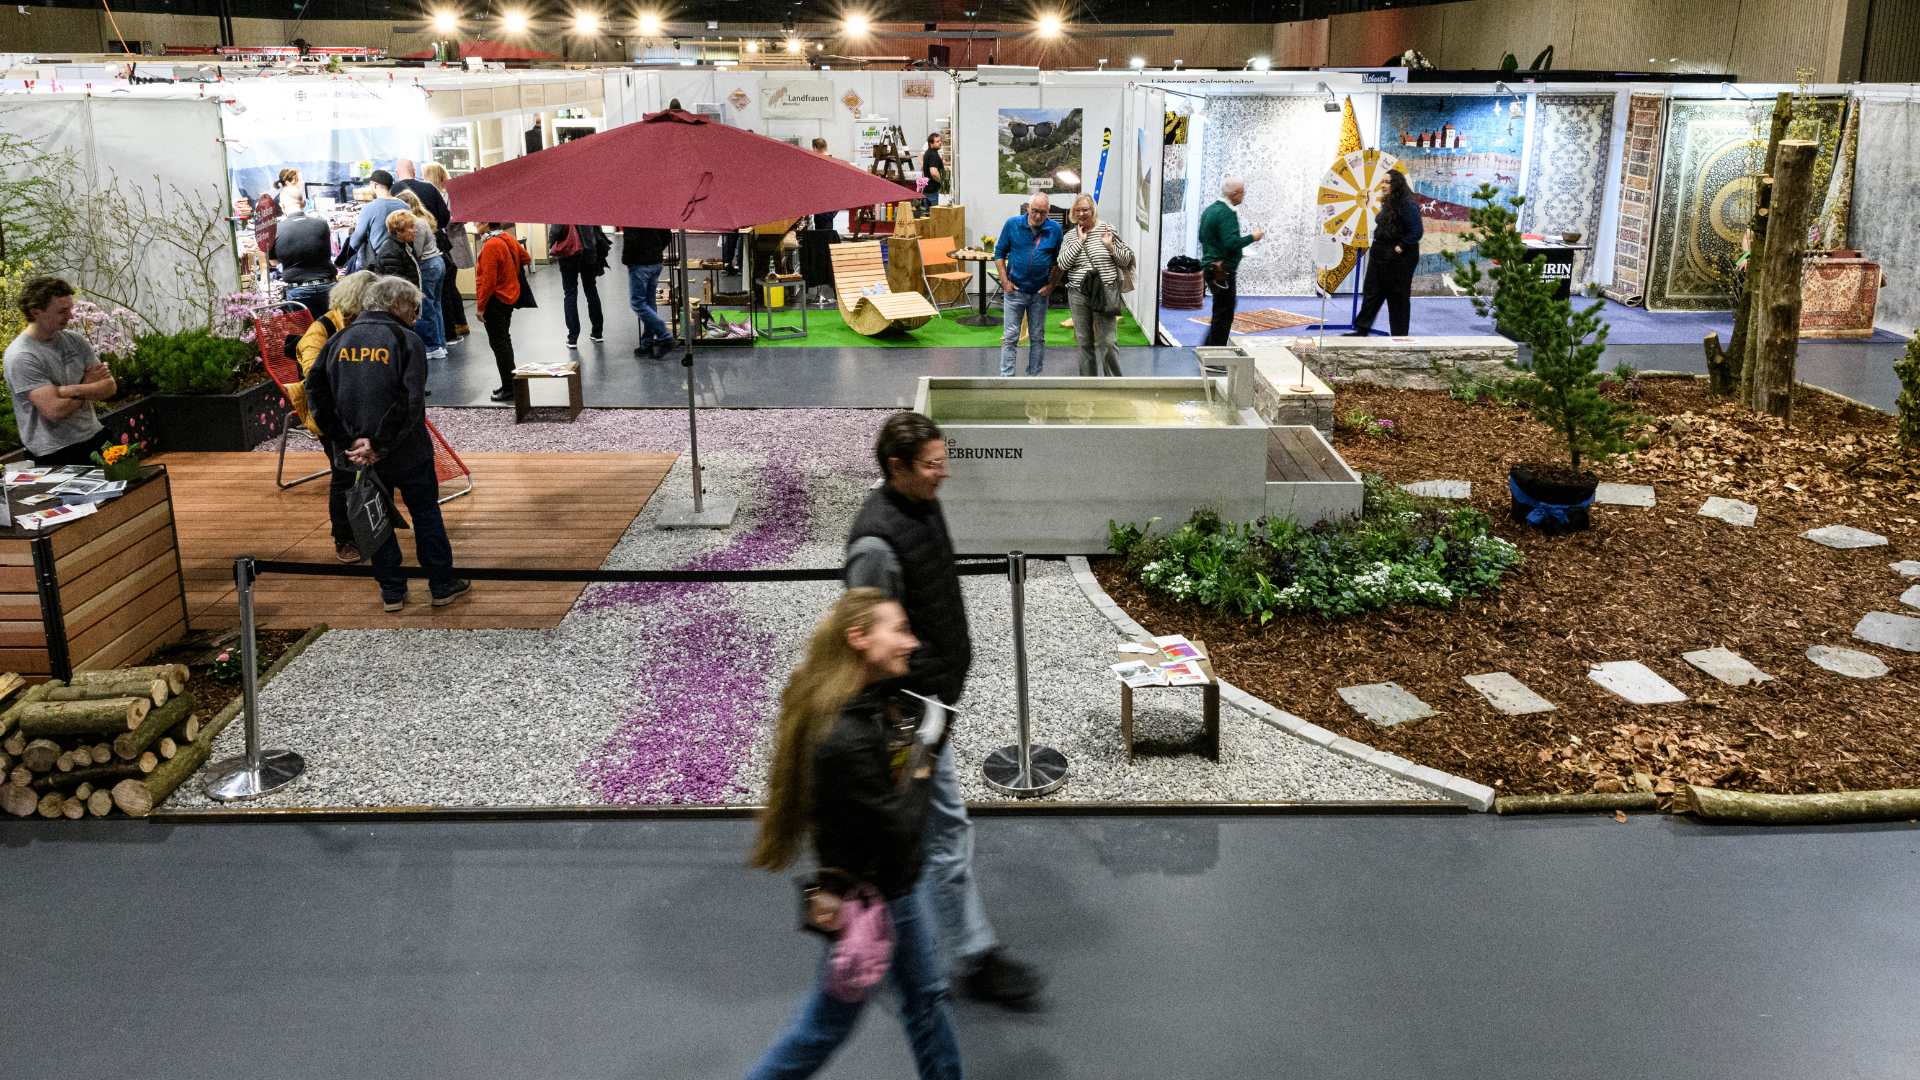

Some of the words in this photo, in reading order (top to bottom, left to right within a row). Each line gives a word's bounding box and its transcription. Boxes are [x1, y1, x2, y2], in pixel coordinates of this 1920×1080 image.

[788, 94, 829, 102] Landfrauen
[338, 347, 390, 365] ALPIQ
[944, 448, 1023, 459] EBRUNNEN
